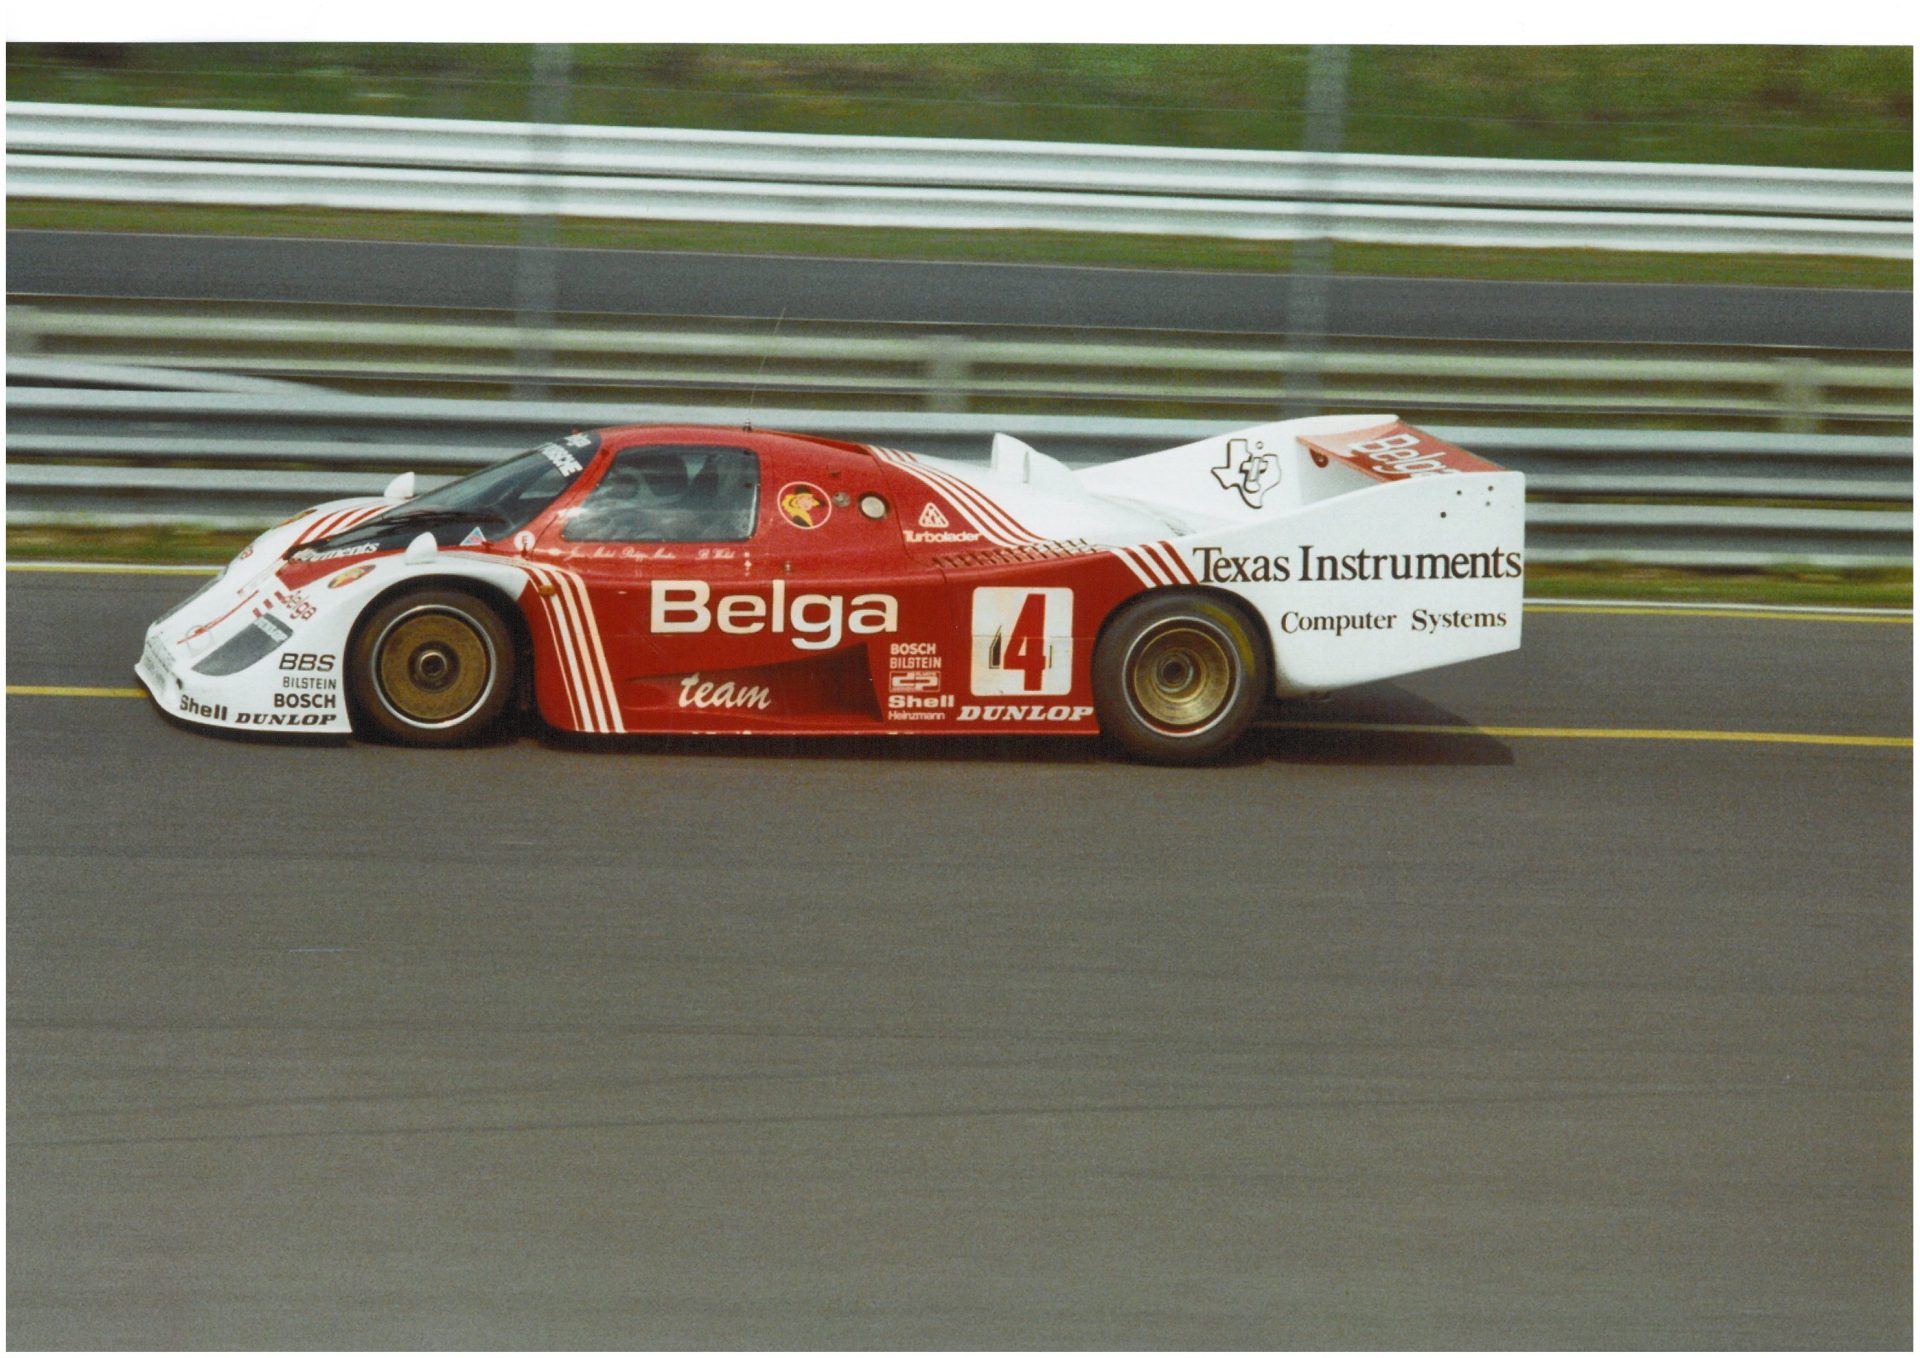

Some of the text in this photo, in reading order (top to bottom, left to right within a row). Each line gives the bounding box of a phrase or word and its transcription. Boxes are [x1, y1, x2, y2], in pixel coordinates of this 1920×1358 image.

[1193, 545, 1522, 583] Texas Instruments
[651, 579, 899, 650] Belga
[1281, 609, 1508, 637] Computer Systems
[890, 643, 937, 655] BOSCH
[1003, 593, 1047, 691] 4
[279, 653, 336, 672] BBS
[889, 656, 942, 669] BILSTEIN
[283, 676, 337, 690] BILSTEIN
[678, 672, 772, 710] team
[180, 694, 228, 721] Shell
[274, 693, 337, 708] BOSCH
[888, 695, 954, 708] Shell
[235, 712, 337, 726] DUNLOP
[888, 710, 946, 721] Heinzmann
[956, 705, 1094, 721] DUNLOP
